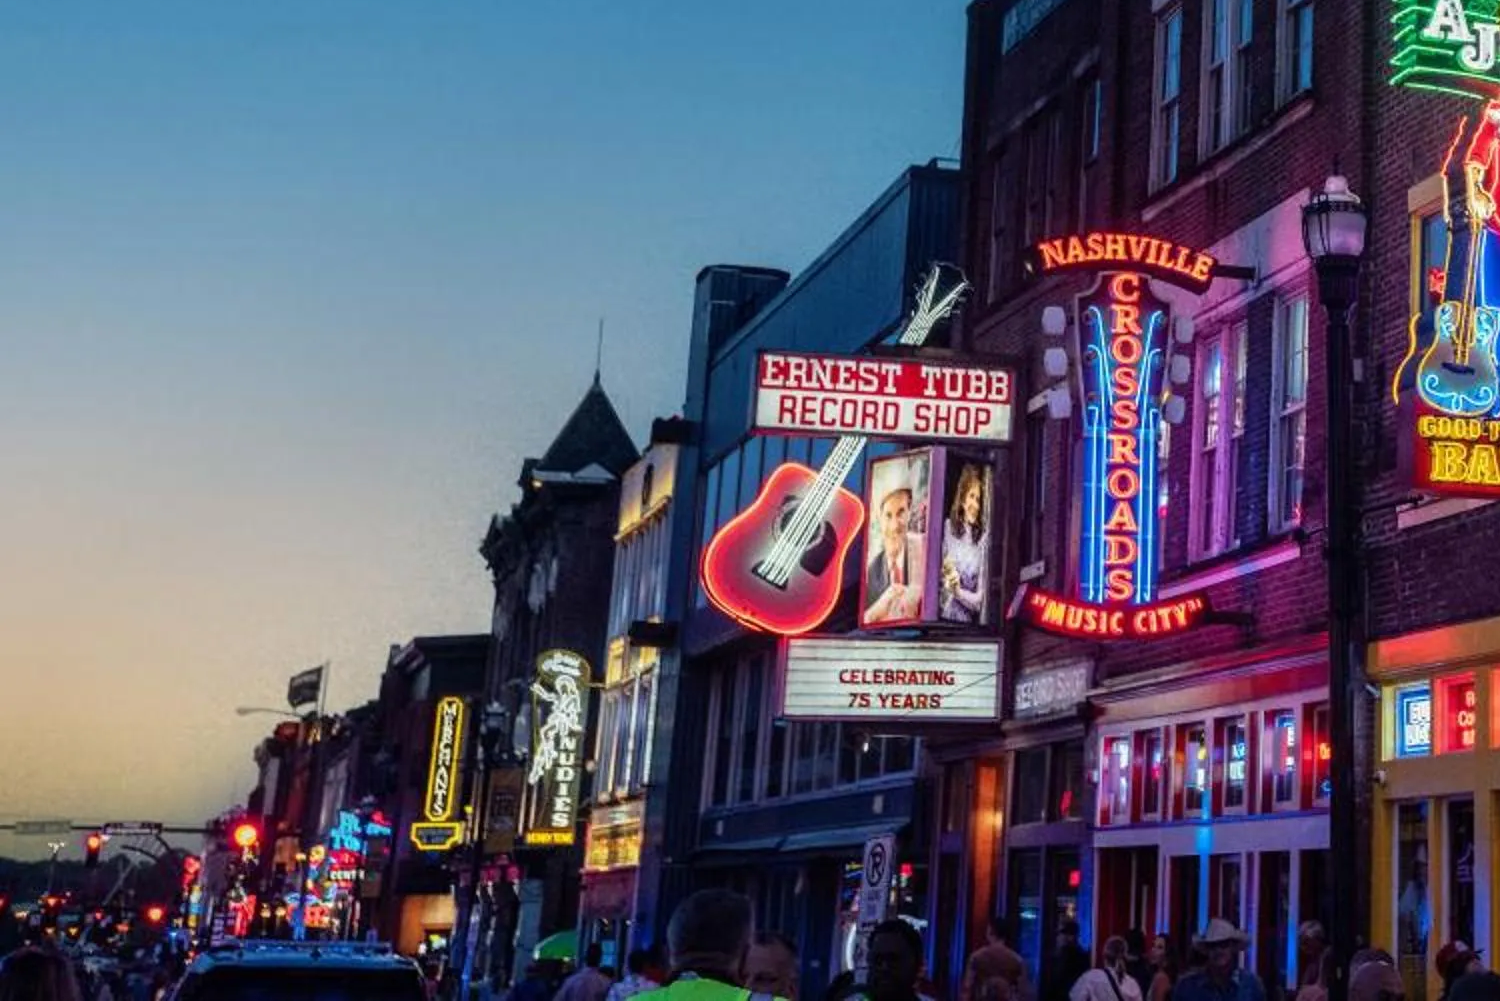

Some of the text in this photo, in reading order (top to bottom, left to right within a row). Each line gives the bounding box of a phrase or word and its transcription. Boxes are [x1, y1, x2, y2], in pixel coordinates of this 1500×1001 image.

[1039, 232, 1214, 281] NASHVILLE
[761, 354, 1010, 401] ERNEST TUBB
[779, 394, 992, 435] RECORD SHOP
[1104, 273, 1142, 600] CROSSROADS
[839, 669, 955, 685] CELEBRATING
[848, 693, 942, 709] 75 YEARS
